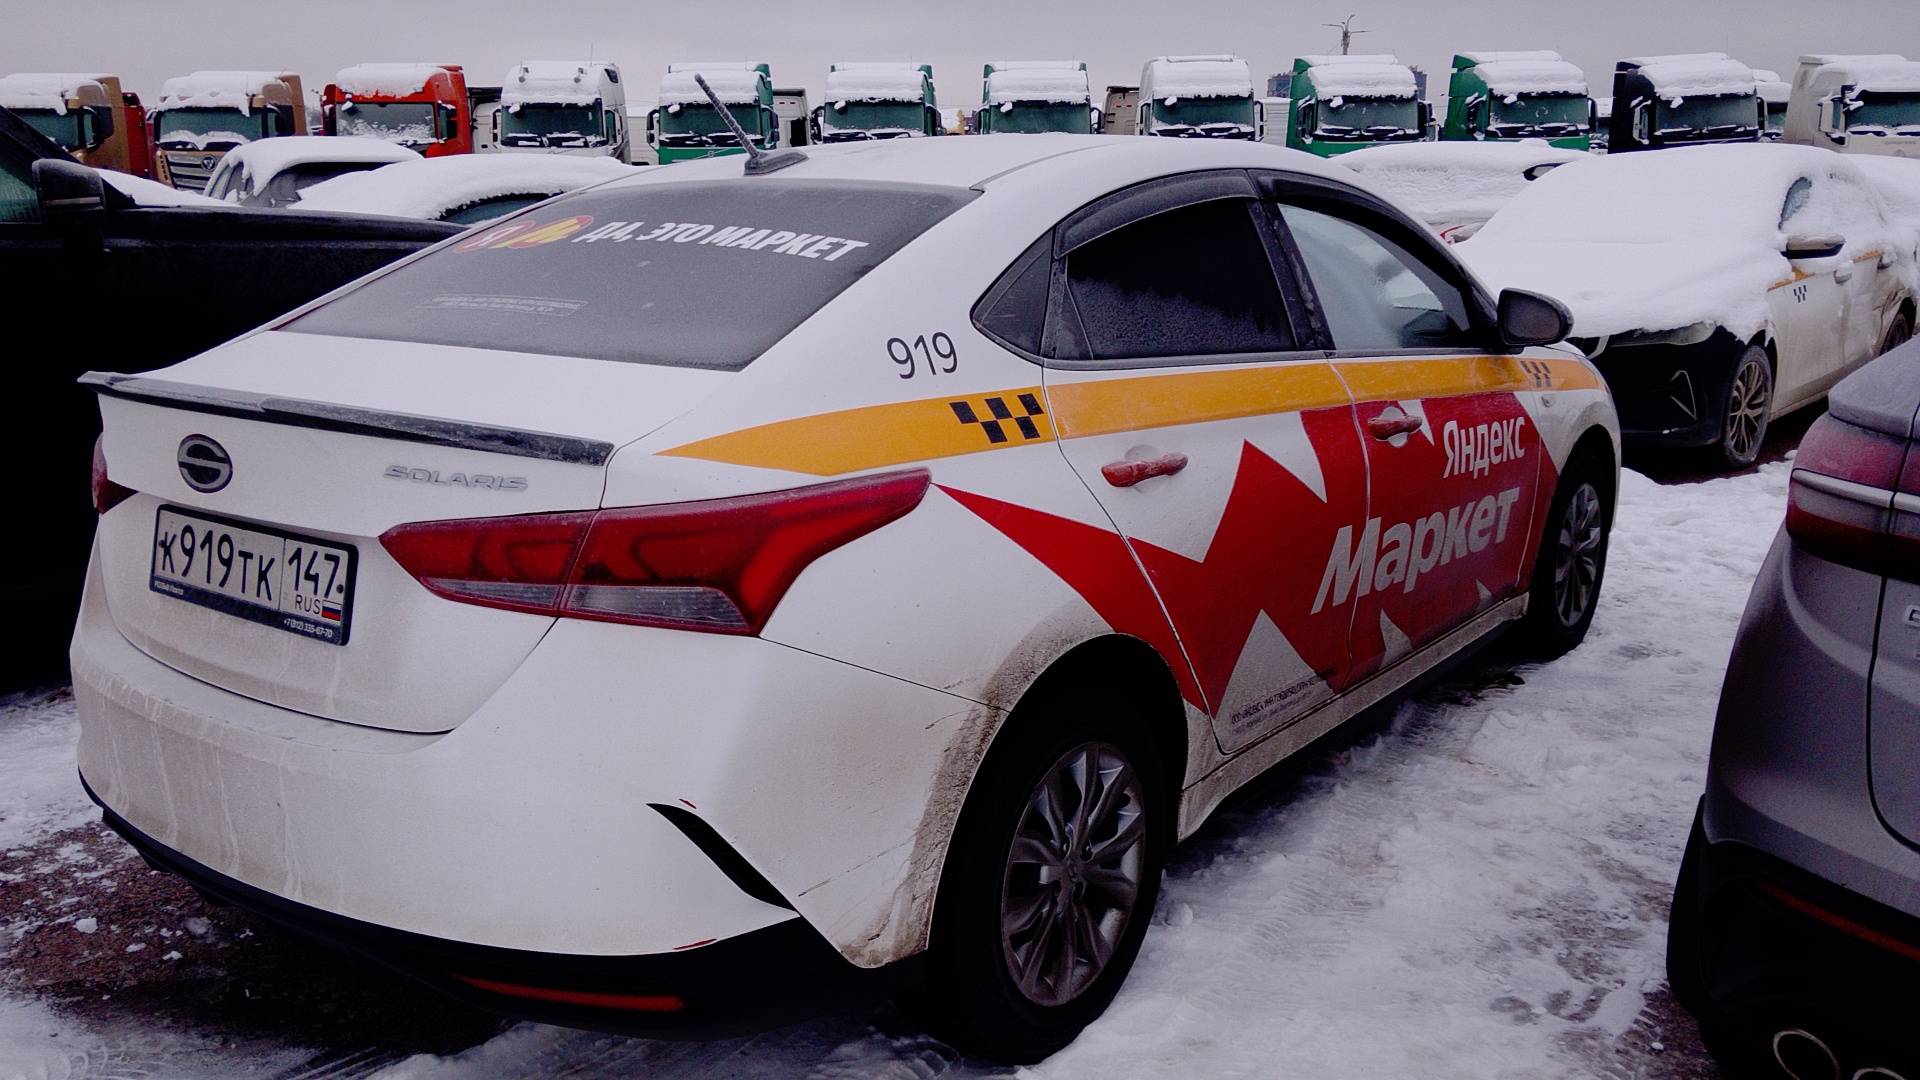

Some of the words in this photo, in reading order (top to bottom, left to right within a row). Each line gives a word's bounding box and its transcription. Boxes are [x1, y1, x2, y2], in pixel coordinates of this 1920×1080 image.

[571, 221, 645, 242] ДА,
[635, 222, 714, 242] ЭТО
[696, 225, 869, 261] МАРКЕТ
[886, 331, 958, 379] 919
[1442, 416, 1525, 479] Яндекс
[383, 464, 529, 492] SOLARIS
[288, 547, 340, 599] 147
[1310, 487, 1520, 615] Маркет
[294, 594, 321, 615] RUS
